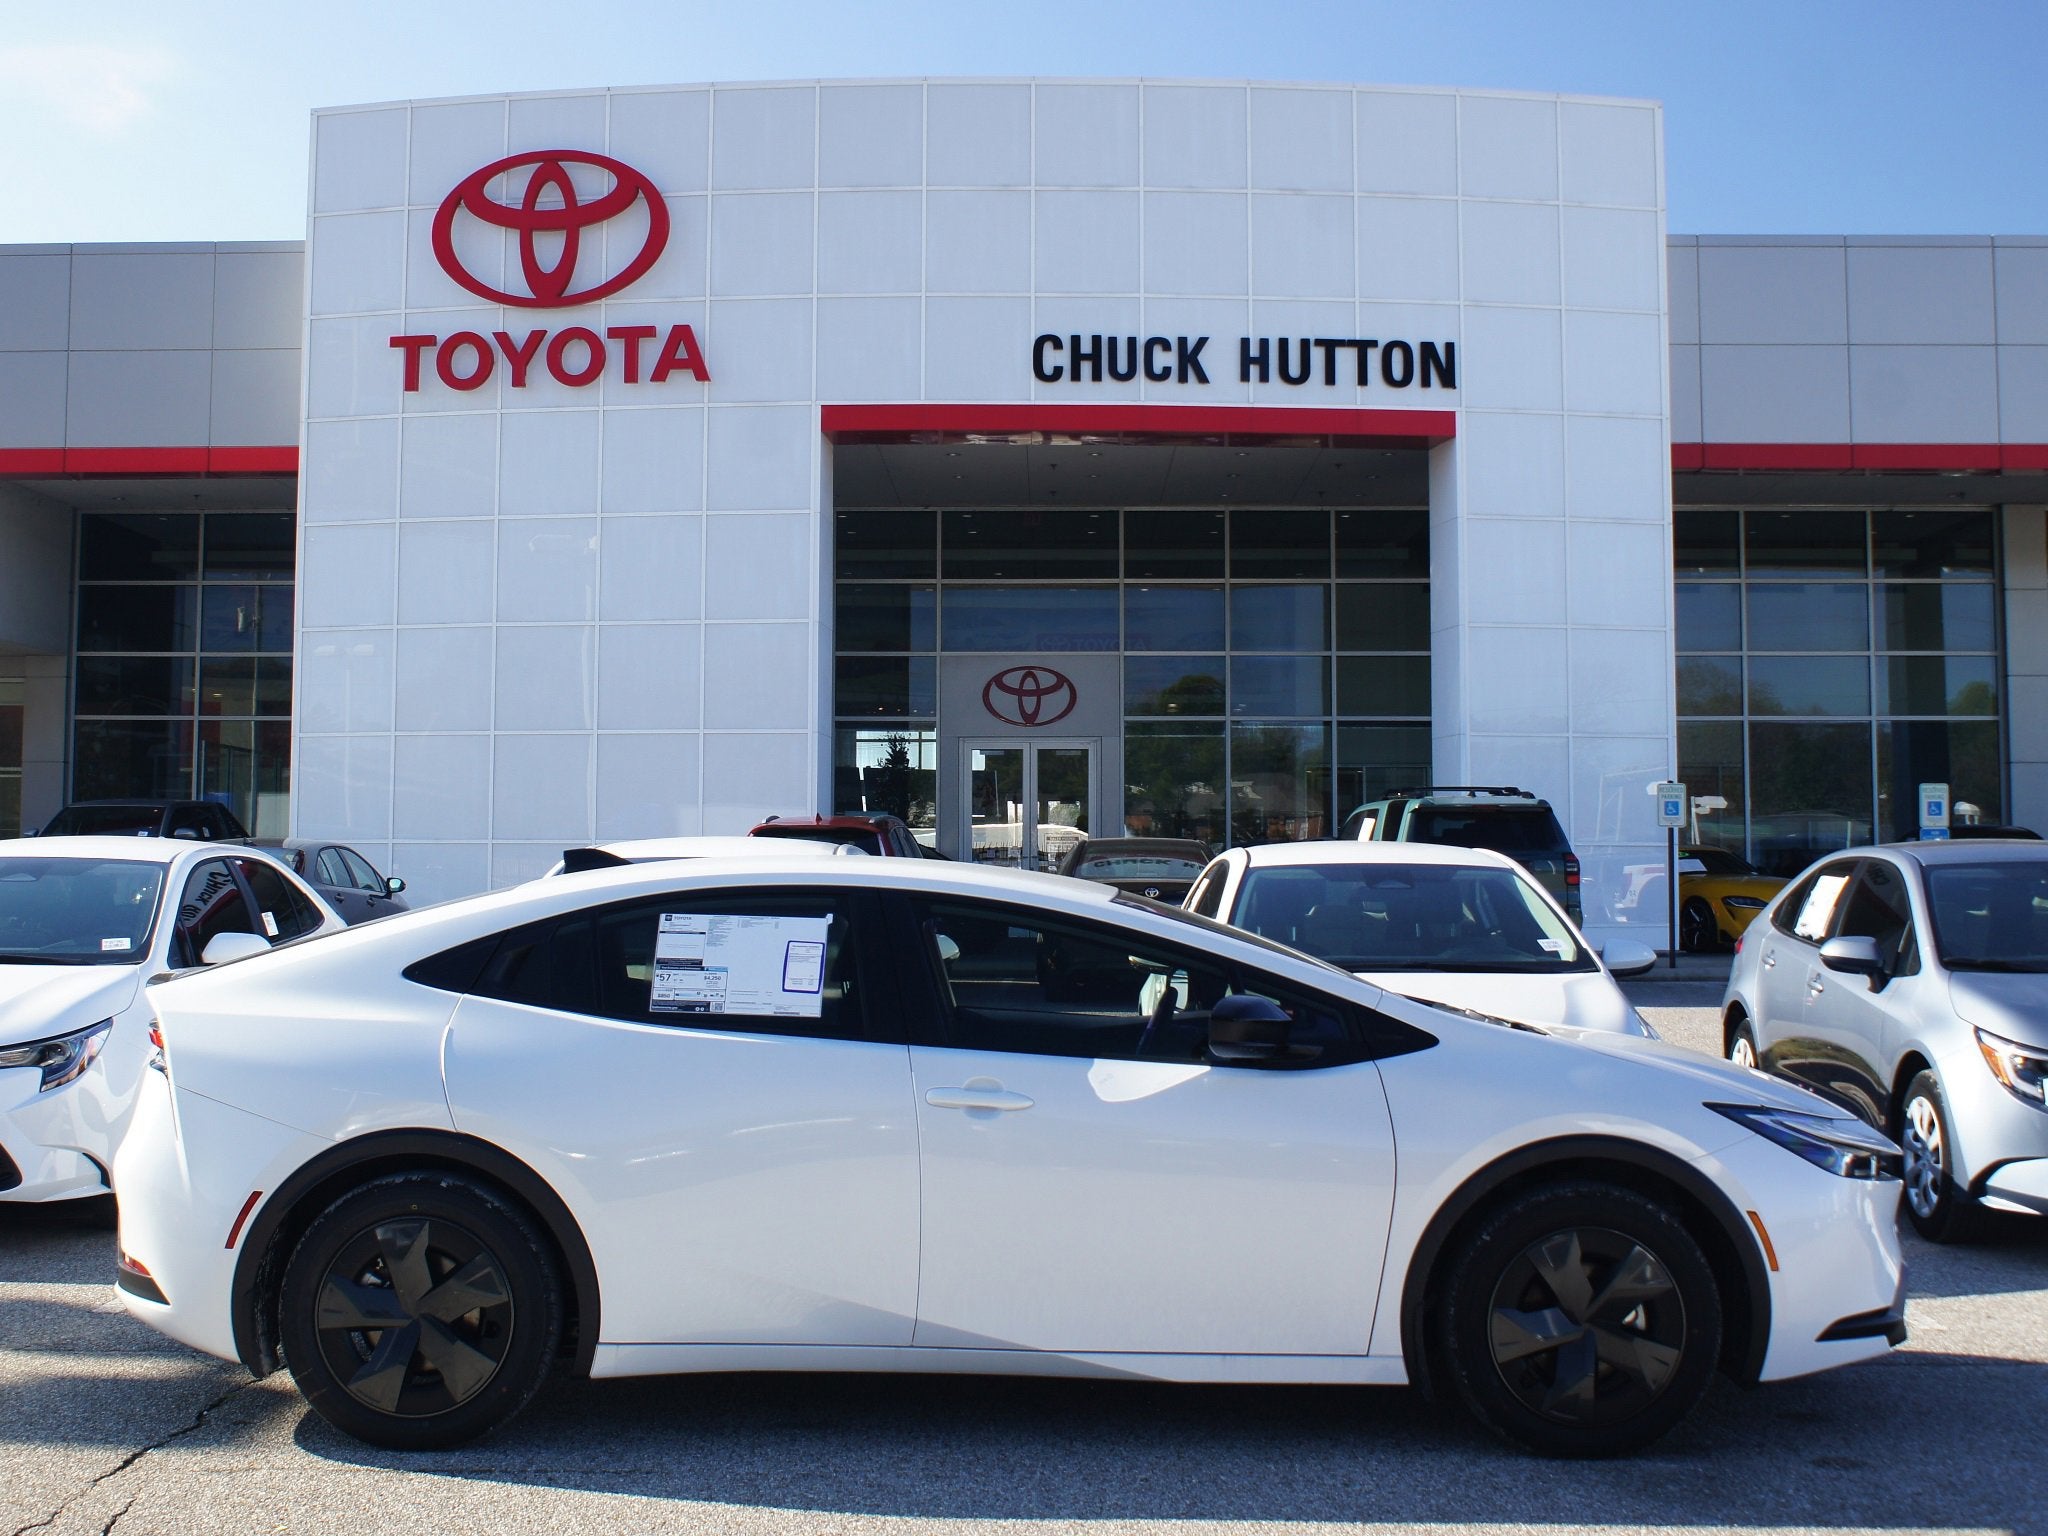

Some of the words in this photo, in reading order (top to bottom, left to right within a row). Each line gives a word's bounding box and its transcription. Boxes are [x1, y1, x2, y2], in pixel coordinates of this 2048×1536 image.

[389, 324, 711, 392] TOYOTA
[1032, 334, 1211, 385] CHUCK
[1239, 336, 1457, 390] HUTTON
[659, 973, 672, 982] 57
